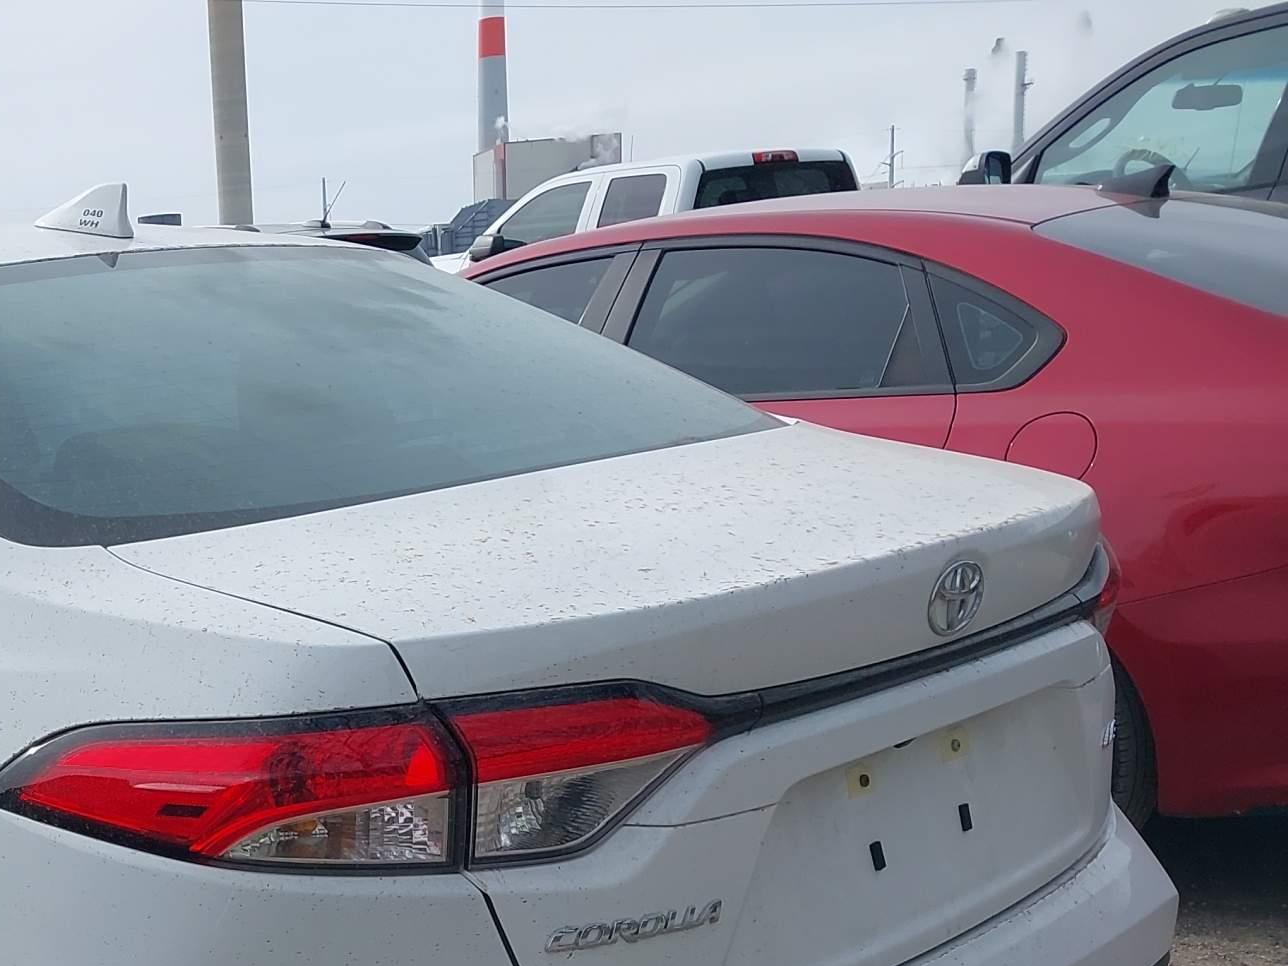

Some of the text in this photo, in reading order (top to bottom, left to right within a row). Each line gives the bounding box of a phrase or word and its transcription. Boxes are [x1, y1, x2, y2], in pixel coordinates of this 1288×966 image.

[83, 208, 103, 218] 040
[79, 218, 99, 228] WH
[544, 899, 723, 953] COROLLA
